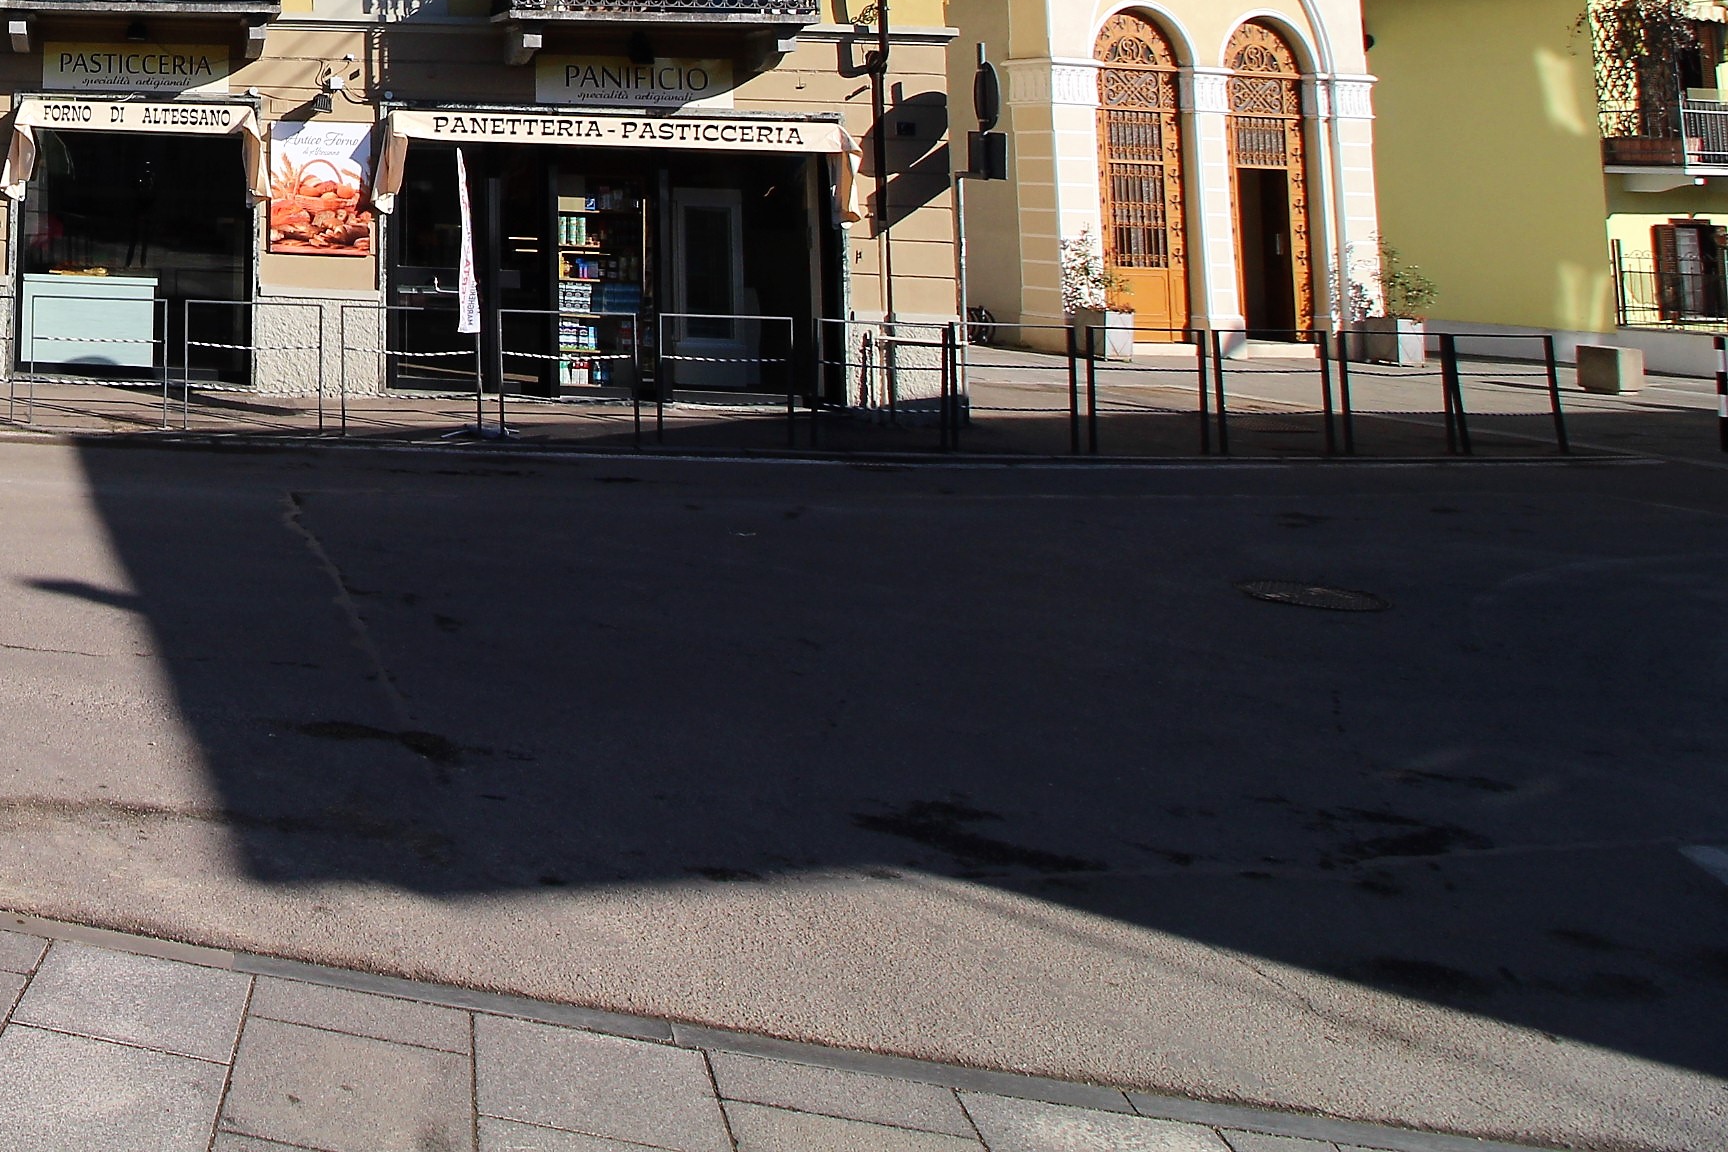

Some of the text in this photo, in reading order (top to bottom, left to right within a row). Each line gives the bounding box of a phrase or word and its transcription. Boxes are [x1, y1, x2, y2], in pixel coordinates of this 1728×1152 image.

[59, 52, 213, 76] PASTICCERIA
[81, 75, 191, 90] specialità artigianali
[564, 64, 709, 91] PANIFICIO
[43, 104, 231, 127] FORNO DI ALTESSANO
[283, 131, 359, 148] Antico Forno
